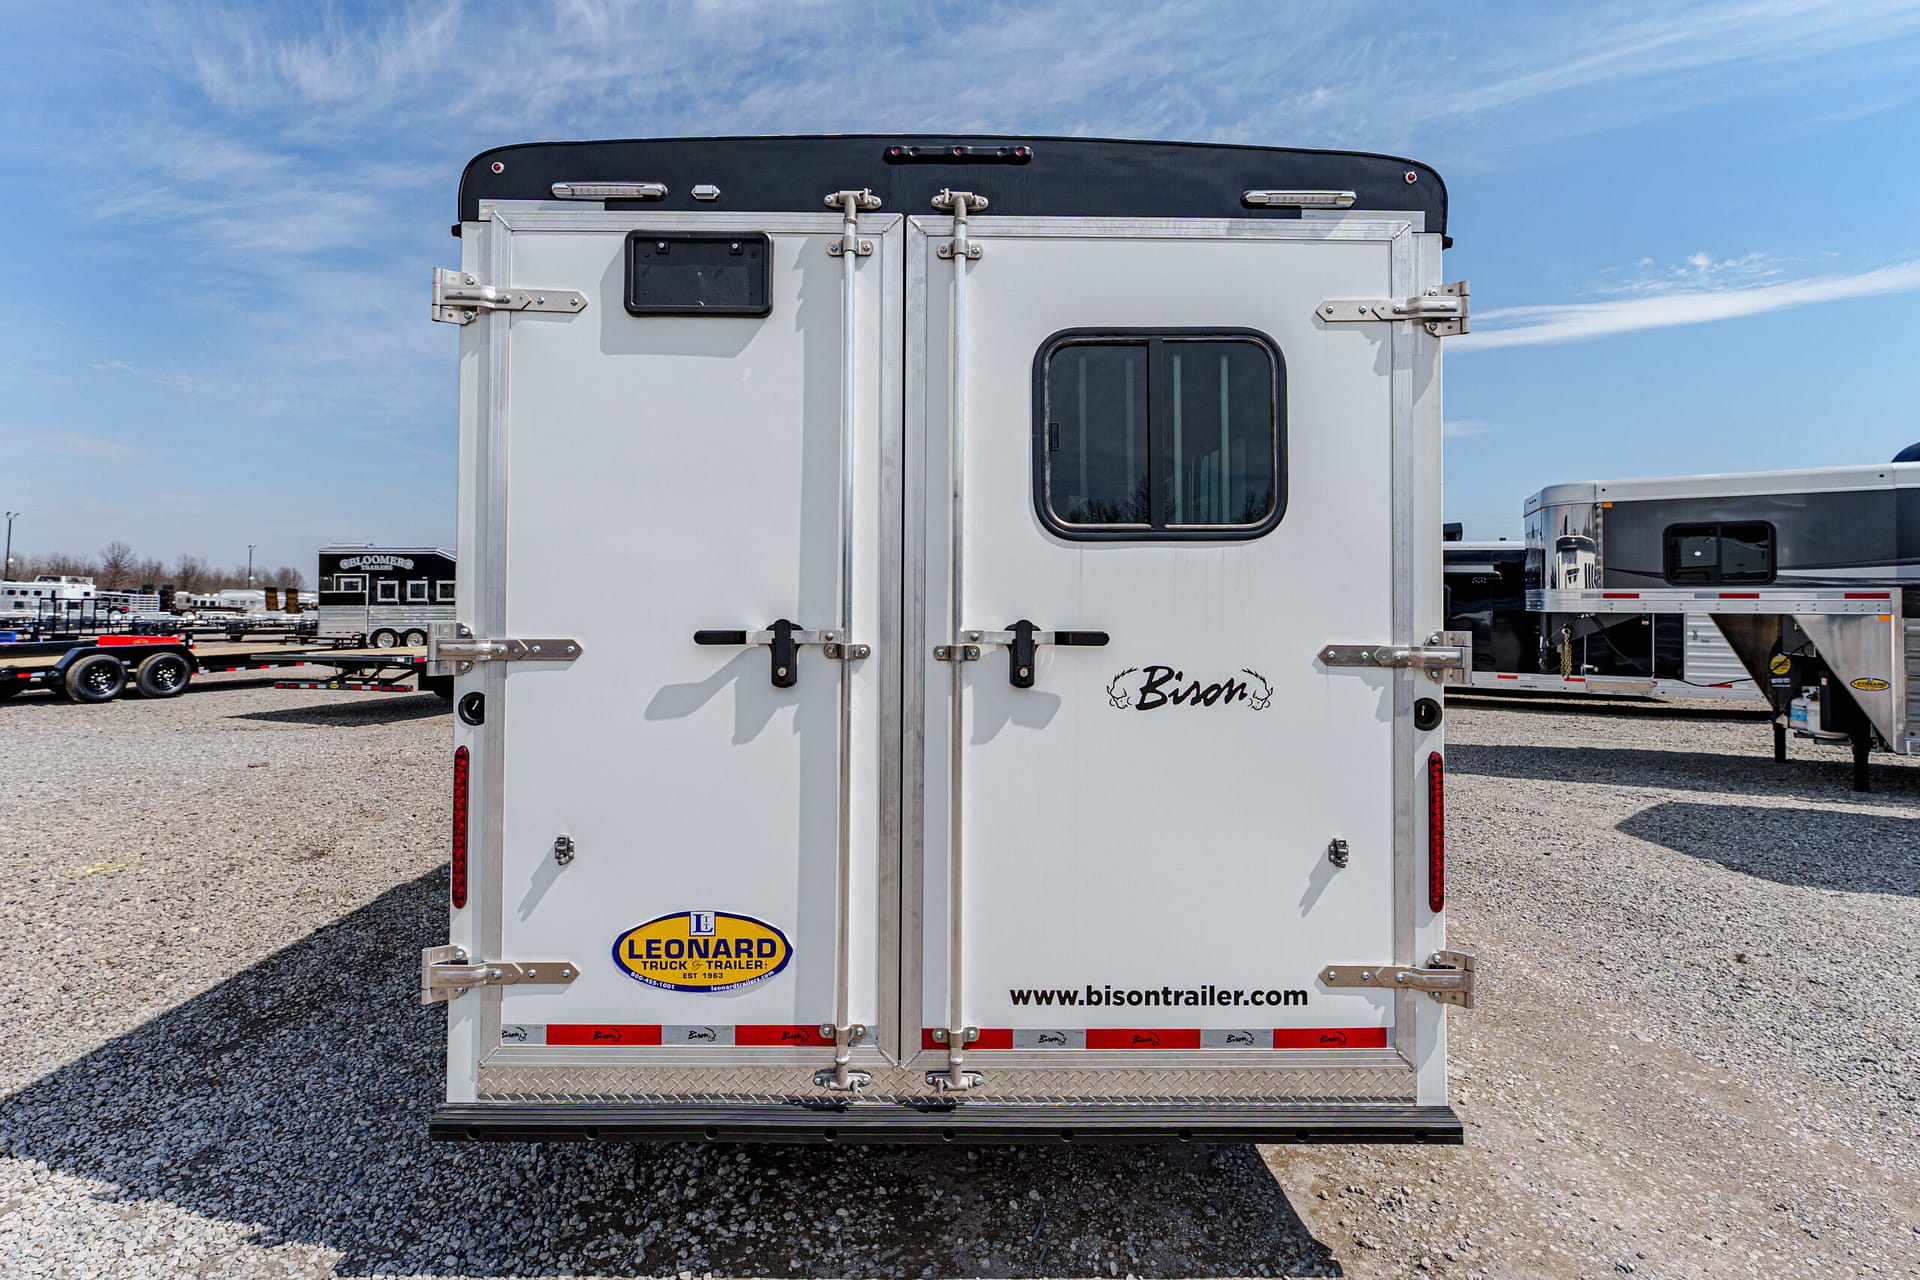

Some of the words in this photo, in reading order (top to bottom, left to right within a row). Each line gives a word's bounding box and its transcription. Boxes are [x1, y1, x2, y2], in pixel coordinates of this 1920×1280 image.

[349, 555, 405, 568] BLOOMER
[1135, 665, 1248, 711] Bison
[628, 938, 776, 960] LEONARD
[641, 960, 688, 970] TRUCK
[706, 960, 763, 970] TRAILER
[630, 972, 675, 990] 800-455-1001
[710, 970, 775, 991] leonardtrailers.com
[1009, 985, 1308, 1006] www.bisontrailer.com
[688, 1030, 709, 1040] Bison
[1038, 1034, 1059, 1044] Bison
[1226, 1034, 1246, 1044] Bison
